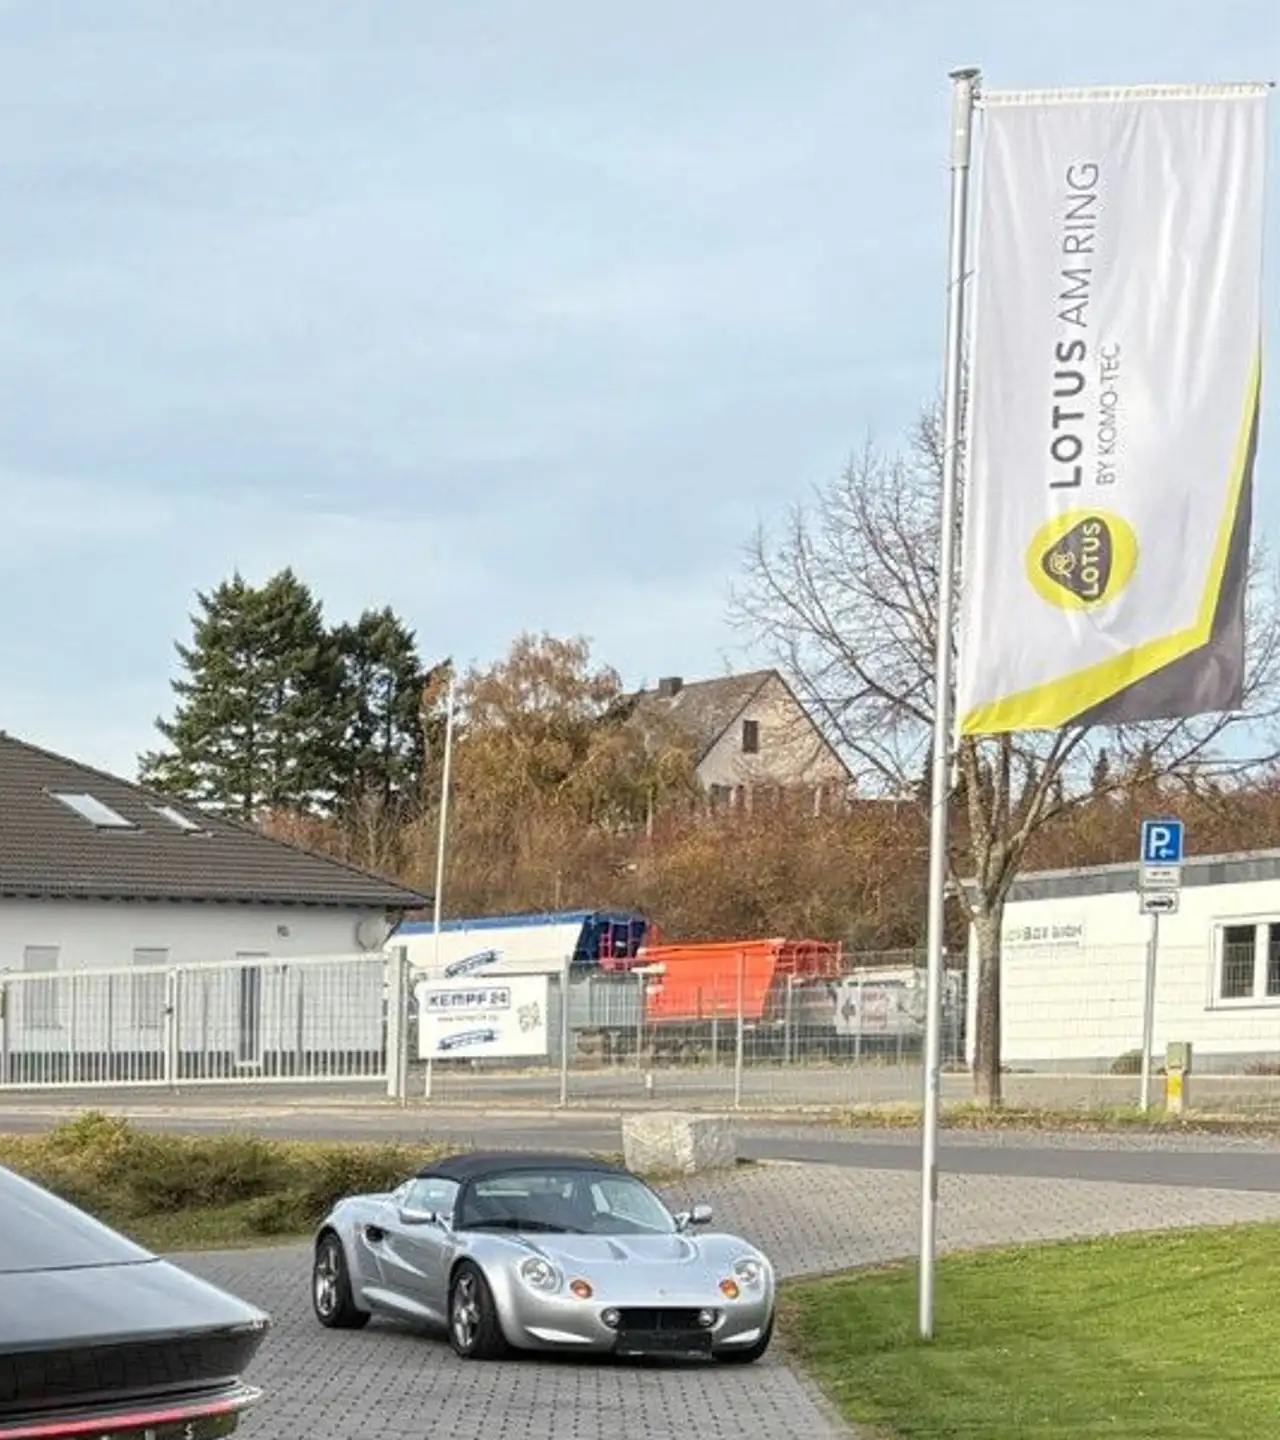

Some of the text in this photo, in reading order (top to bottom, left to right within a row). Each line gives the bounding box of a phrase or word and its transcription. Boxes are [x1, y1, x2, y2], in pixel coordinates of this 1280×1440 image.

[1048, 162, 1100, 490] LOTUS AM RING
[1095, 341, 1122, 487] BY KOMO-TEC
[1080, 521, 1104, 597] LOTUS
[1149, 827, 1172, 858] P
